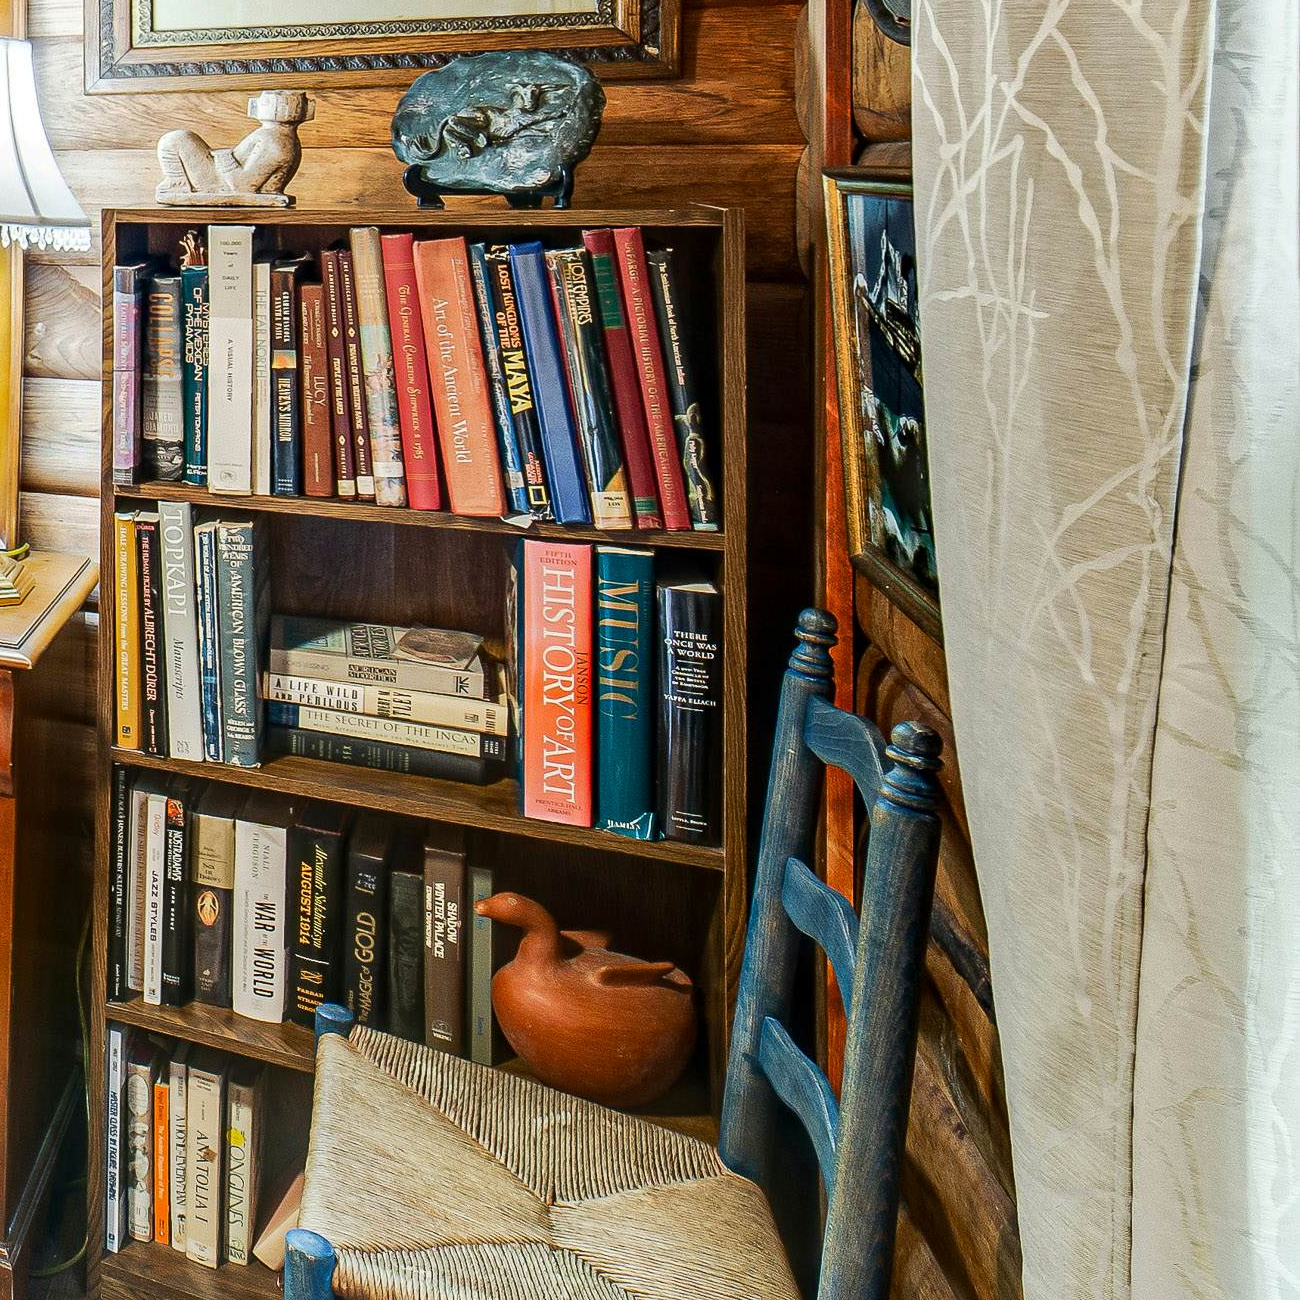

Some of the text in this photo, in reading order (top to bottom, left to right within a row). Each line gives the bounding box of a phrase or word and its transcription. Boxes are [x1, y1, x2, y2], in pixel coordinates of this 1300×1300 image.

[658, 262, 667, 272] The
[282, 291, 291, 315] GRAHAM
[328, 273, 336, 301] AMERICAN
[343, 273, 351, 301] AMERICAN
[568, 262, 593, 325] LOST EMPIRES
[497, 264, 522, 348] LOST KINGDOMS
[633, 297, 648, 343] PICTORIAL
[665, 304, 675, 318] Book
[148, 292, 175, 378] COLLAPSE
[185, 303, 195, 364] PYRAMIDS
[194, 287, 203, 382] OF THE MEXICAN
[255, 289, 268, 378] THE FAR NORTH
[495, 311, 510, 349] OF THE
[669, 325, 679, 341] North
[333, 357, 341, 377] PEOPLE
[641, 346, 656, 384] HISTORY
[671, 341, 682, 365] American
[398, 284, 425, 459] THE GENERAL CARLETON SHIPWRECK 1785
[432, 298, 472, 464] Art of the Ancient World
[502, 348, 533, 416] MAYA
[314, 376, 326, 406] LUCY
[334, 386, 343, 397] THE
[649, 387, 659, 399] OF
[279, 412, 293, 442] MIRROR
[651, 403, 663, 420] THE
[653, 422, 670, 470] AMERICAN
[663, 473, 677, 507] INDIAN
[119, 526, 128, 547] HALE
[142, 536, 151, 549] THE
[119, 550, 129, 588] DRAWING
[142, 549, 151, 575] HUMAN
[163, 509, 187, 617] TOPKAPI
[539, 557, 577, 566] EDITION
[545, 550, 572, 558] FIFTH
[142, 575, 151, 598] FIGURE
[119, 589, 129, 622] LESSONS
[120, 639, 129, 650] the
[143, 607, 156, 665] ALBRECHT
[229, 572, 248, 715] AMERICAN BLOWN GLASS
[599, 576, 640, 720] MUSIC
[663, 638, 717, 651] ONCE WAS
[673, 630, 708, 641] THERE
[120, 651, 129, 675] GREAT
[173, 637, 185, 700] Manuscripts
[348, 664, 397, 677] AFRICAN
[677, 648, 715, 660] WORLD
[121, 675, 130, 711] MASTERS
[145, 665, 158, 701] DÜRER
[275, 677, 359, 700] A LIFE WILD
[348, 671, 397, 684] STORIES
[542, 565, 576, 804] HISTORY OF ART
[575, 649, 589, 705] JANSON
[275, 691, 359, 712] AND PERILOUS
[306, 709, 331, 723] THE
[334, 715, 378, 731] SECRET
[384, 721, 402, 733] OF
[406, 724, 431, 739] THE
[435, 729, 477, 745] INCAS
[251, 832, 260, 879] FERGUSON
[262, 844, 270, 871] NIALL
[150, 870, 159, 898] JAZZ
[312, 844, 328, 949] Alexander Solzhenitsyn
[299, 861, 312, 945] AUGUST 1914
[149, 901, 158, 942] STYLES
[434, 881, 445, 959] WINTER PALACE
[446, 901, 458, 943] SHADOW
[252, 901, 276, 998] WAR WORLD
[354, 911, 377, 1011] MAGIC GOLD
[109, 1090, 118, 1115] MASTER
[109, 1116, 118, 1137] CLASS
[157, 1125, 165, 1134] The
[109, 1146, 118, 1169] FIGURE
[195, 1130, 209, 1223] ANATOLIA I
